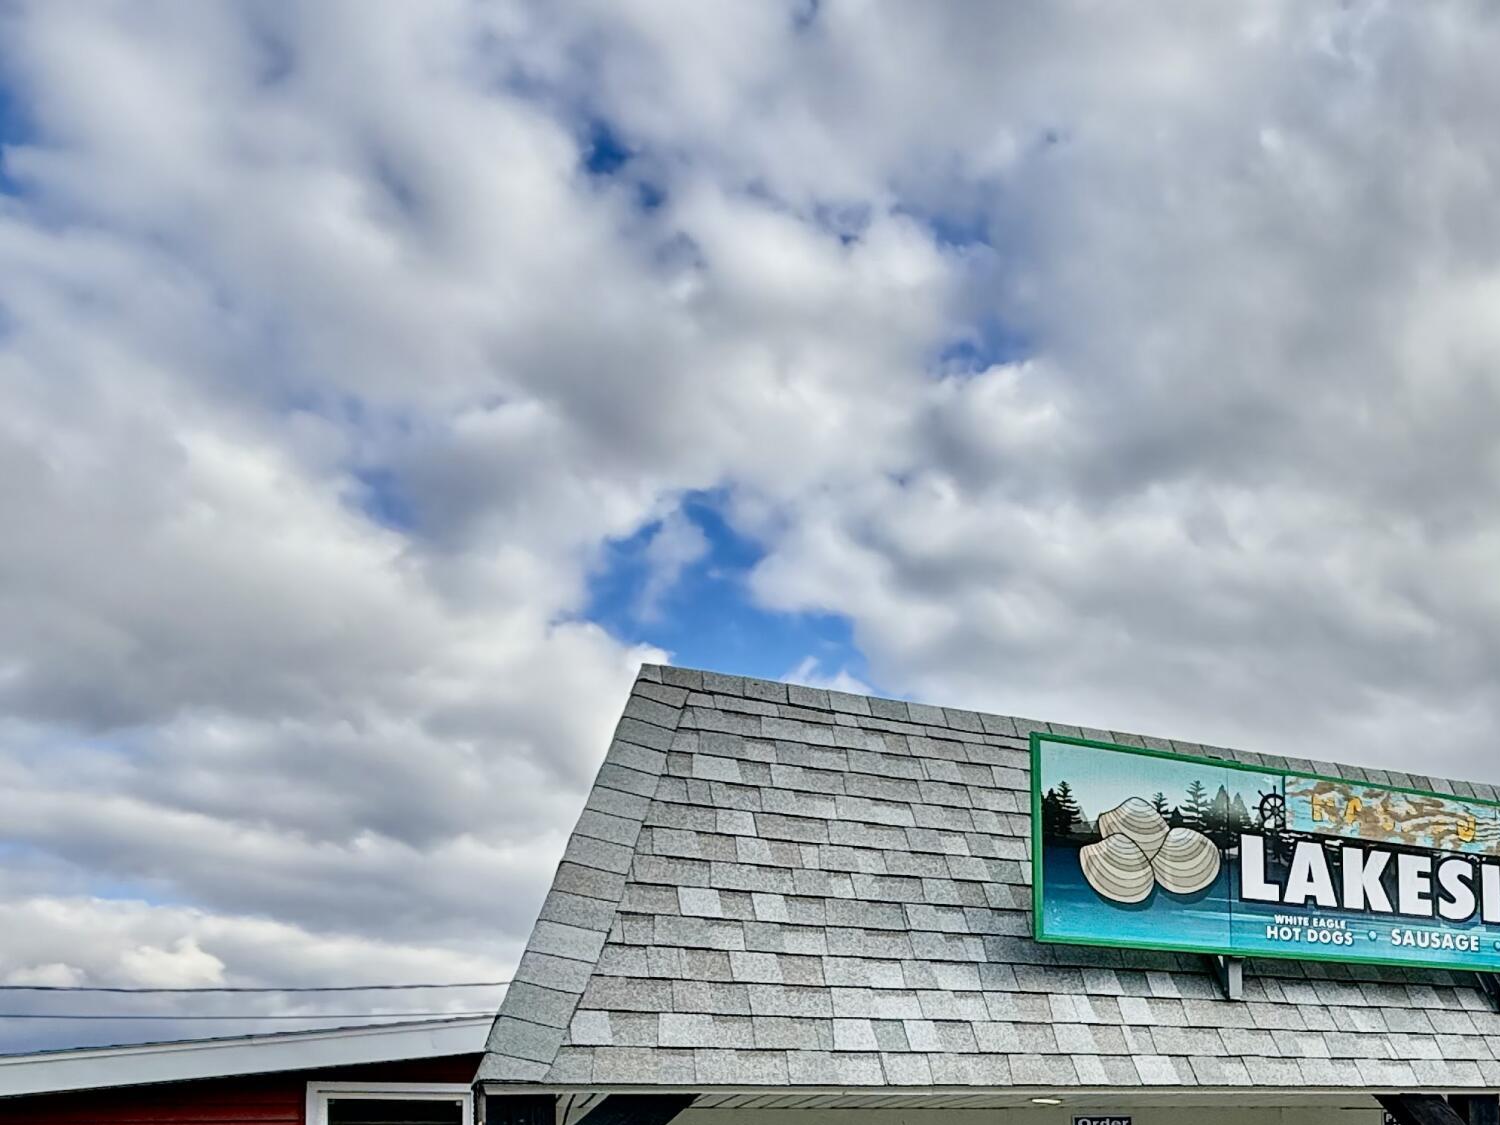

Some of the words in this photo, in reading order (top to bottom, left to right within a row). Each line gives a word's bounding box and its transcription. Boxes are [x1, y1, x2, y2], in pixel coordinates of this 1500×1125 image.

[1274, 914, 1309, 927] WHITE
[1312, 917, 1347, 930] EAGLE
[1266, 926, 1301, 942] HOT
[1307, 929, 1353, 946] DOGS
[1391, 929, 1480, 951] SAUSAGE
